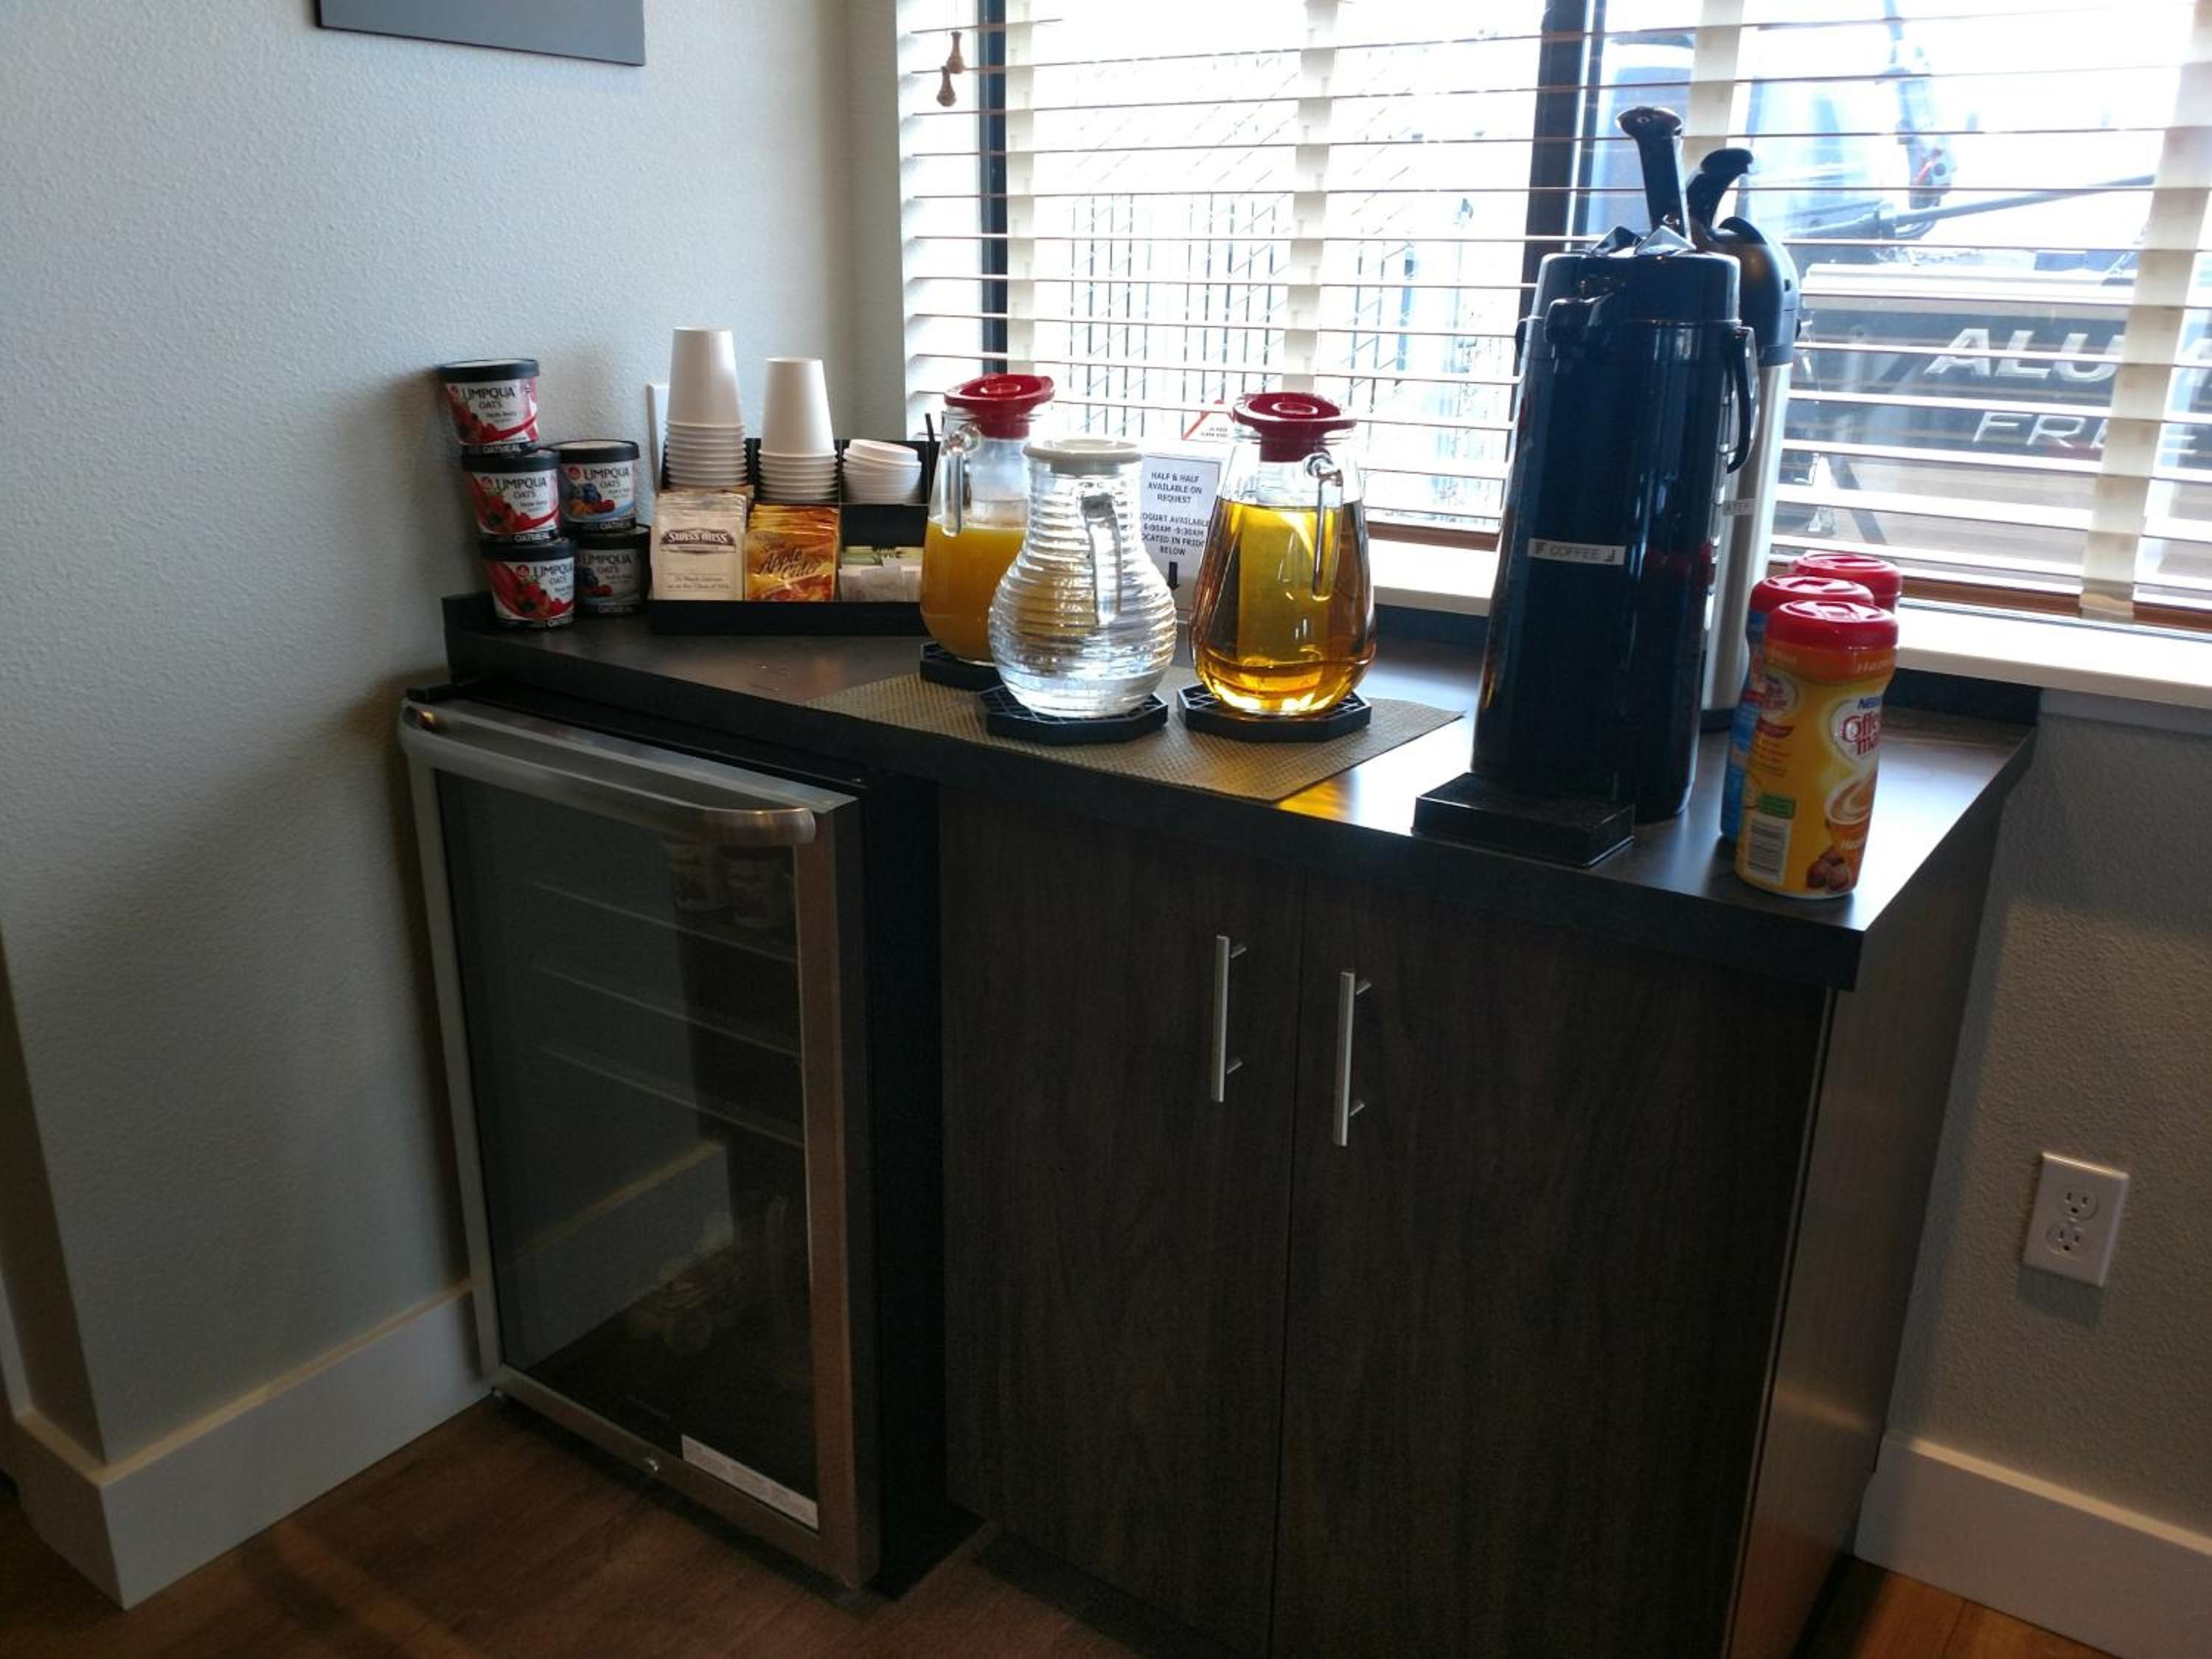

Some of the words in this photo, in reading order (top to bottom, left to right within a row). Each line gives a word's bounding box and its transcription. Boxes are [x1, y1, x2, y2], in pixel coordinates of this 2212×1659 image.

[461, 387, 516, 400] UMPQUA
[479, 400, 504, 409] OATS
[583, 467, 629, 480] UMPQUA
[1151, 472, 1170, 480] HALF
[1172, 473, 1178, 481] &
[1179, 474, 1200, 483] HALF
[495, 476, 547, 490] UMPQUA
[600, 480, 622, 489] OATS
[1147, 481, 1189, 493] AVAILABLE
[1190, 486, 1203, 494] ON
[514, 490, 536, 499] OATS
[1157, 493, 1192, 503] REQUEST
[1141, 512, 1168, 522] OGURT
[1141, 533, 1170, 543] OCATED
[1172, 537, 1180, 545] IN
[1160, 545, 1186, 555] BELOW
[1549, 543, 1600, 560] COFFEE
